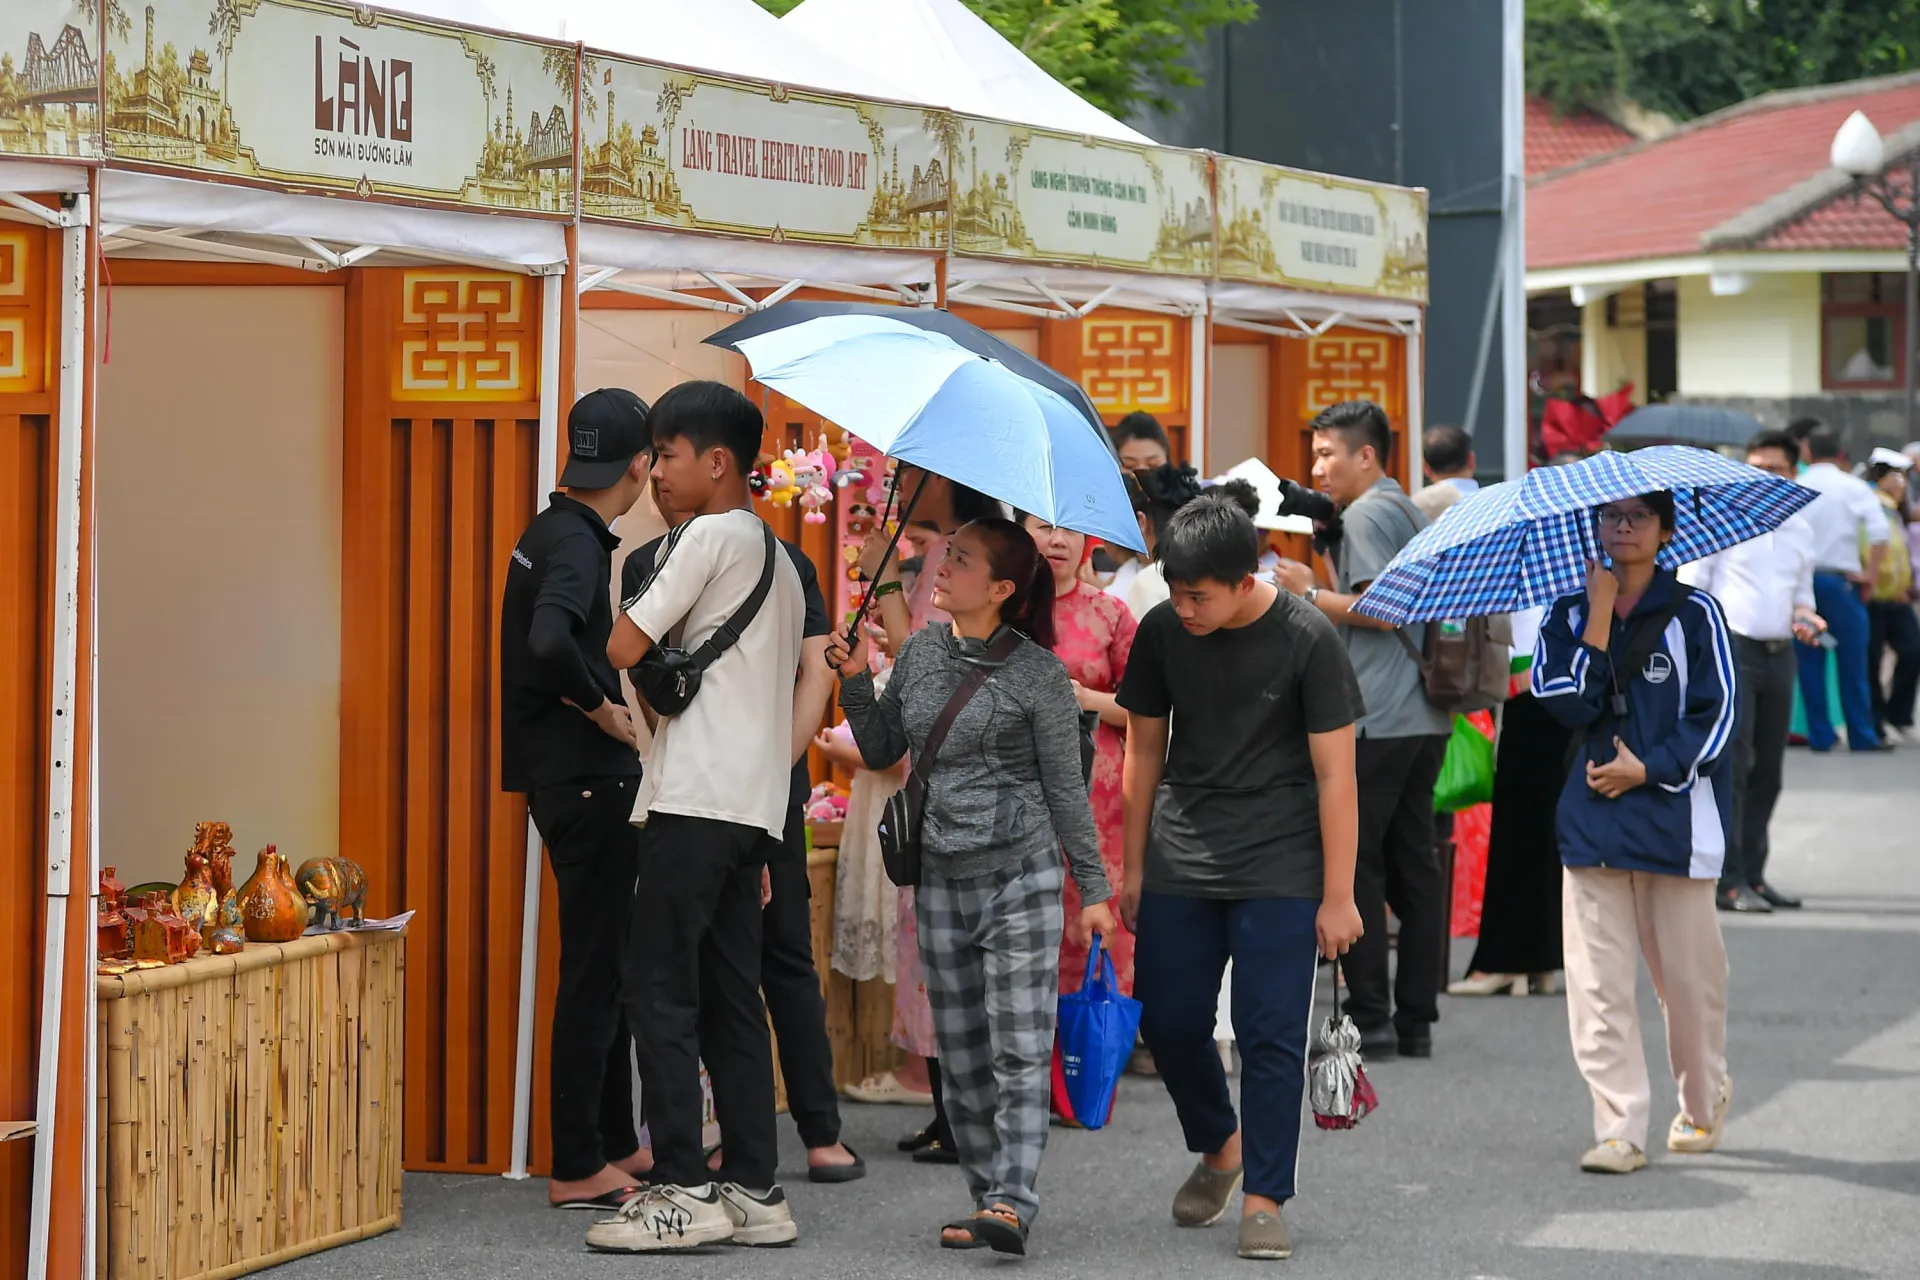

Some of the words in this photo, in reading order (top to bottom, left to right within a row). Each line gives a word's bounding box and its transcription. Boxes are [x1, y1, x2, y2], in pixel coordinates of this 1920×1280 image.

[315, 35, 412, 143] LÀNG
[315, 136, 335, 157] SƠN
[338, 137, 355, 160] MÀI
[358, 141, 391, 164] ĐƯỜNG
[394, 144, 412, 168] LÂM
[683, 119, 712, 171] LÀNG
[716, 133, 758, 178] TRAVEL
[761, 140, 815, 185] HERITAGE
[818, 147, 845, 188] FOOD
[847, 151, 868, 190] ART
